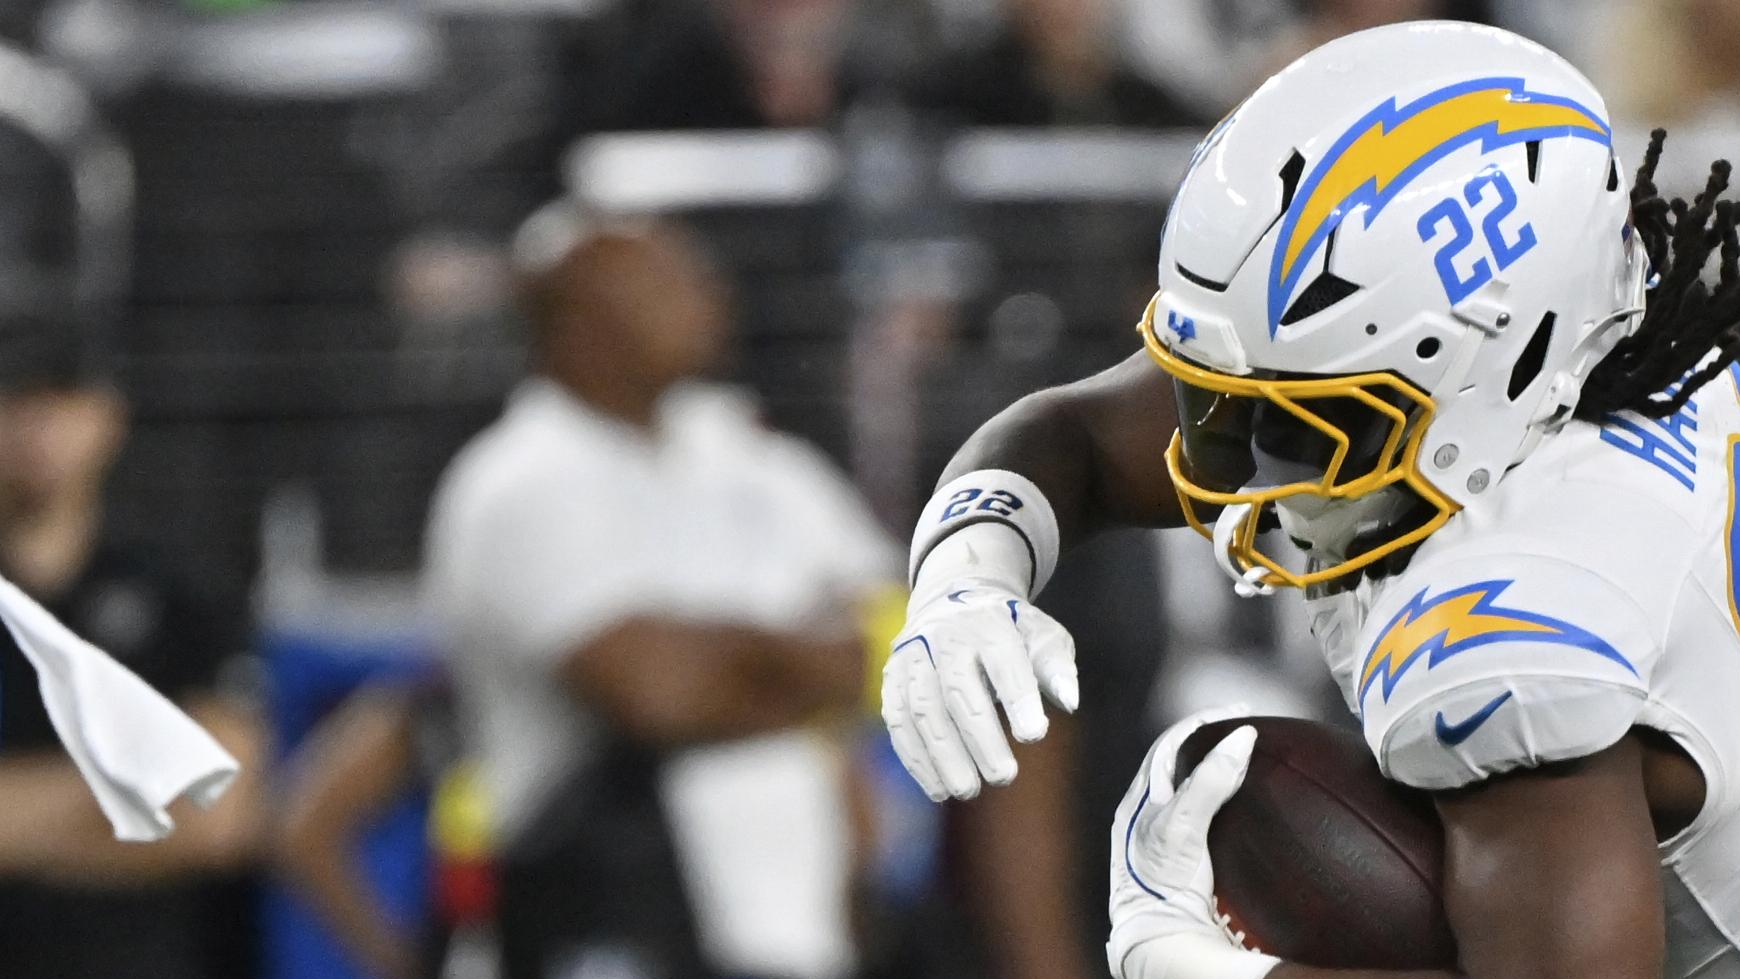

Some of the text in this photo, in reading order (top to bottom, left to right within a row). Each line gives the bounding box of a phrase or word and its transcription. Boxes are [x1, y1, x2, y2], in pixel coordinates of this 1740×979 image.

[1417, 165, 1537, 306] 22
[1599, 368, 1698, 493] HA
[940, 488, 1024, 523] 22
